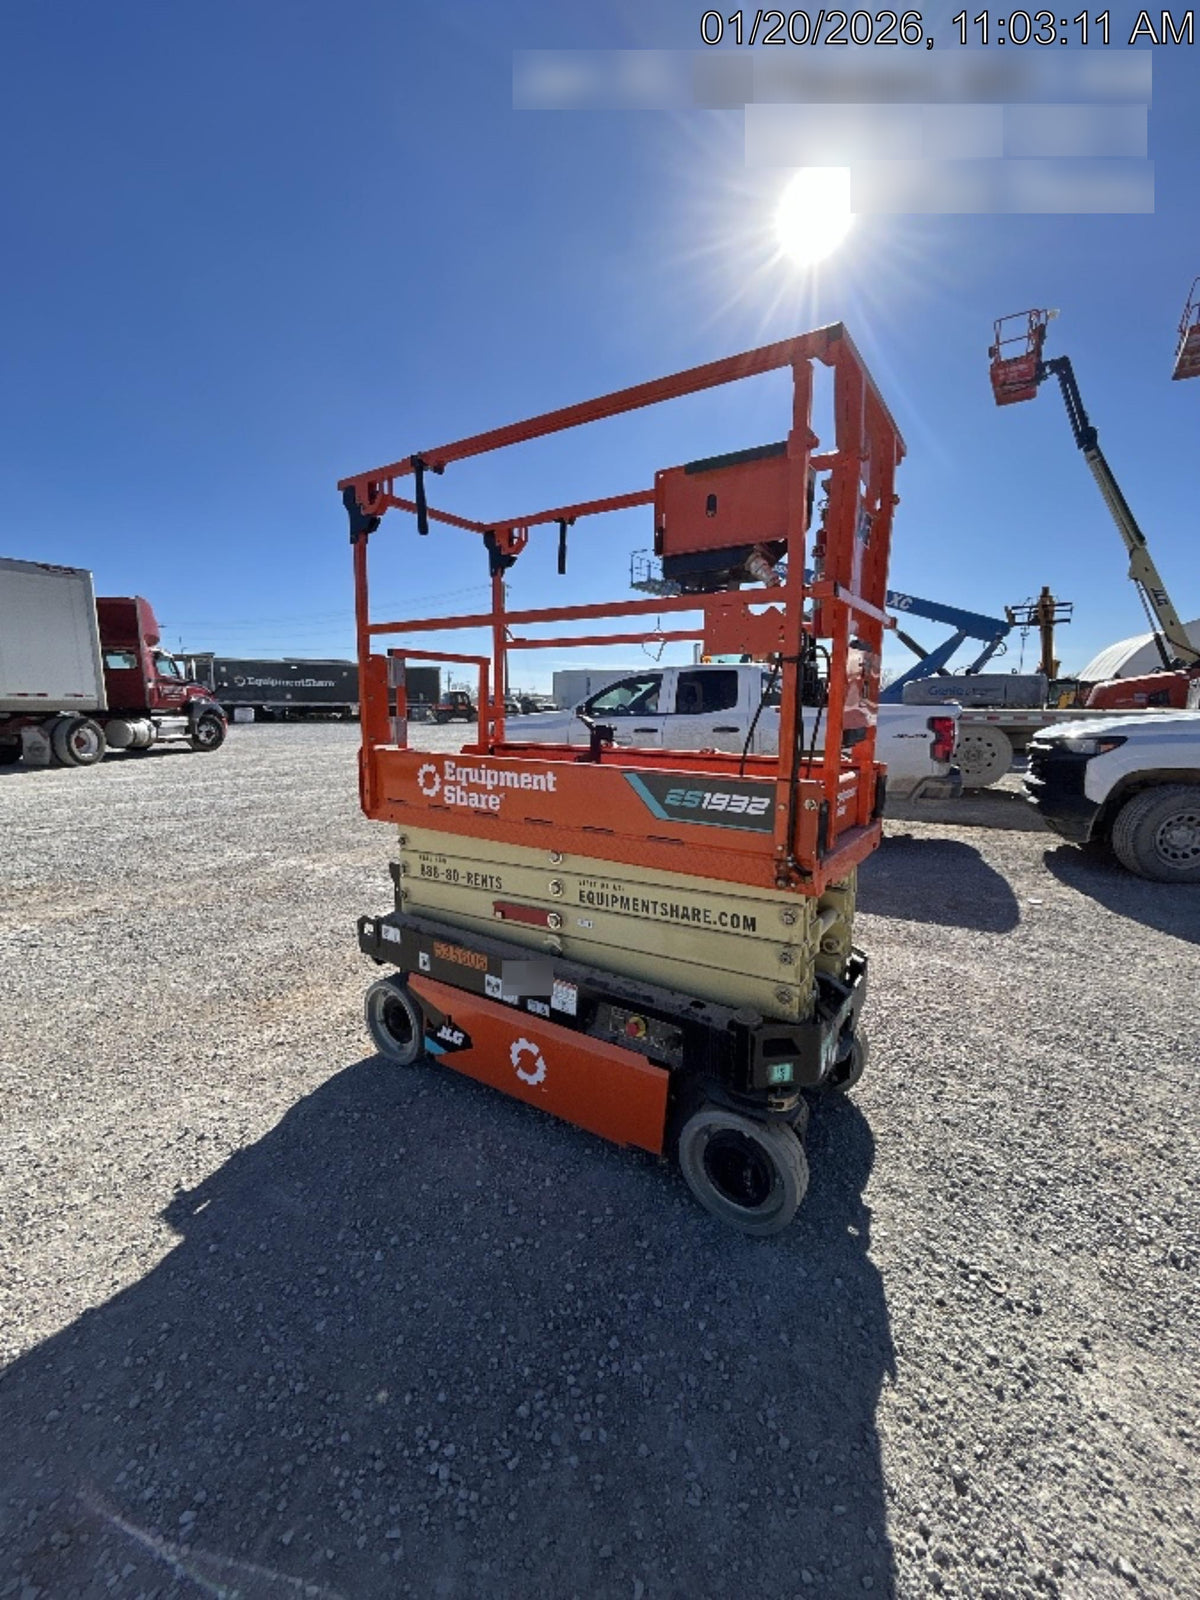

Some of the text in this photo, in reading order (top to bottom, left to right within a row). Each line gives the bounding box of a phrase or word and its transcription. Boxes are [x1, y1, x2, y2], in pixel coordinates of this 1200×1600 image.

[443, 760, 557, 792] Equipment
[443, 785, 500, 811] Share
[664, 788, 771, 815] ES1932
[578, 889, 757, 932] EQUIPMENTSHARE.COM
[437, 1025, 465, 1046] JLG
